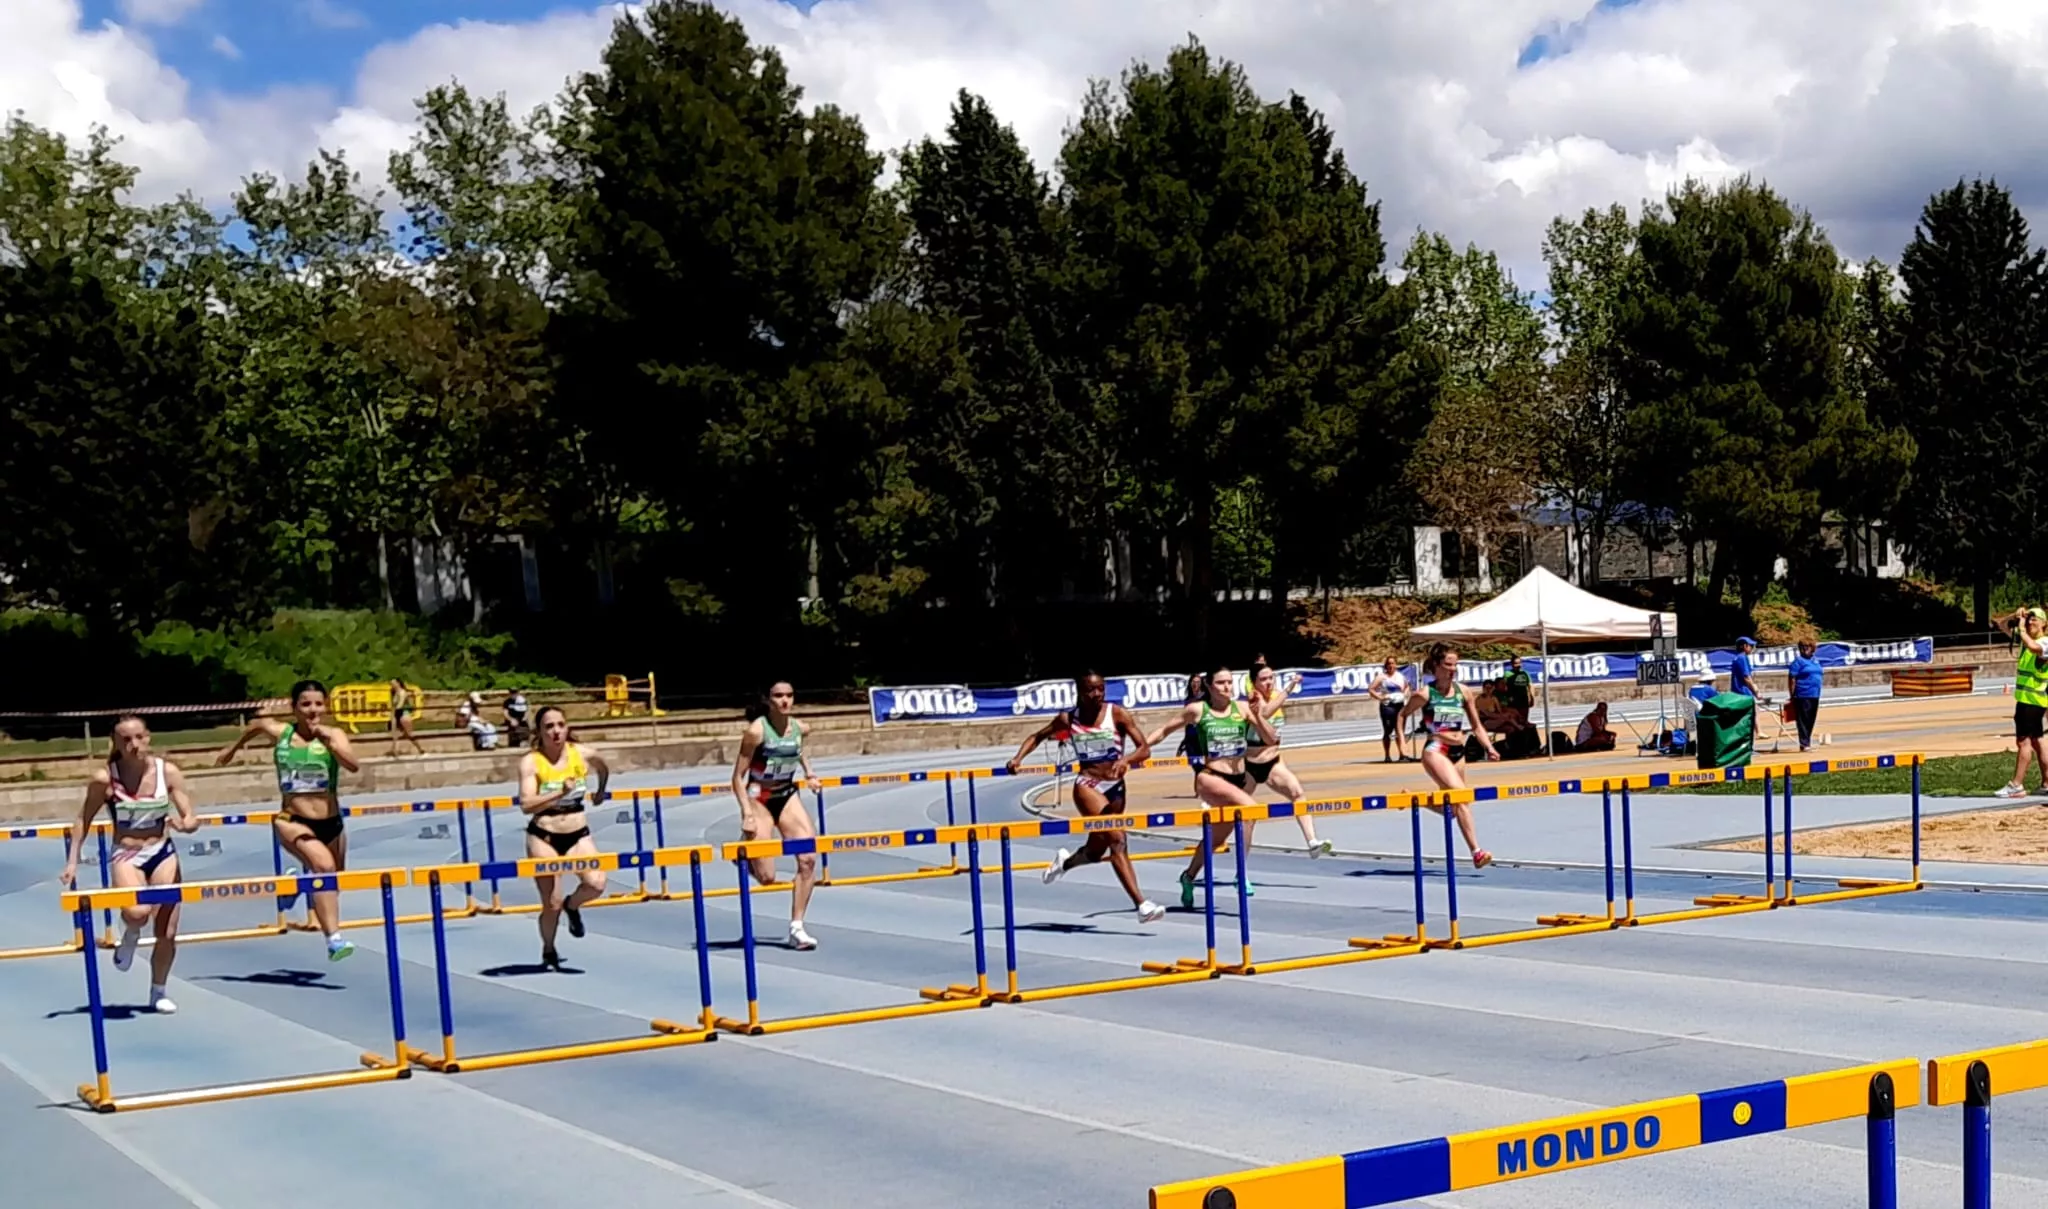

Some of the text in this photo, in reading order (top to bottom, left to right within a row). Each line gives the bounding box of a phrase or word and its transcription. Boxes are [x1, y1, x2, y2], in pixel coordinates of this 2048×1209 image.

[1332, 667, 1385, 694] Jom
[1306, 801, 1351, 812] MONDO
[1083, 817, 1134, 830] MONDO
[832, 835, 890, 849] MONDO
[535, 858, 600, 873] MONDO
[201, 881, 277, 899] MONDO
[1497, 1115, 1661, 1177] MONDO
